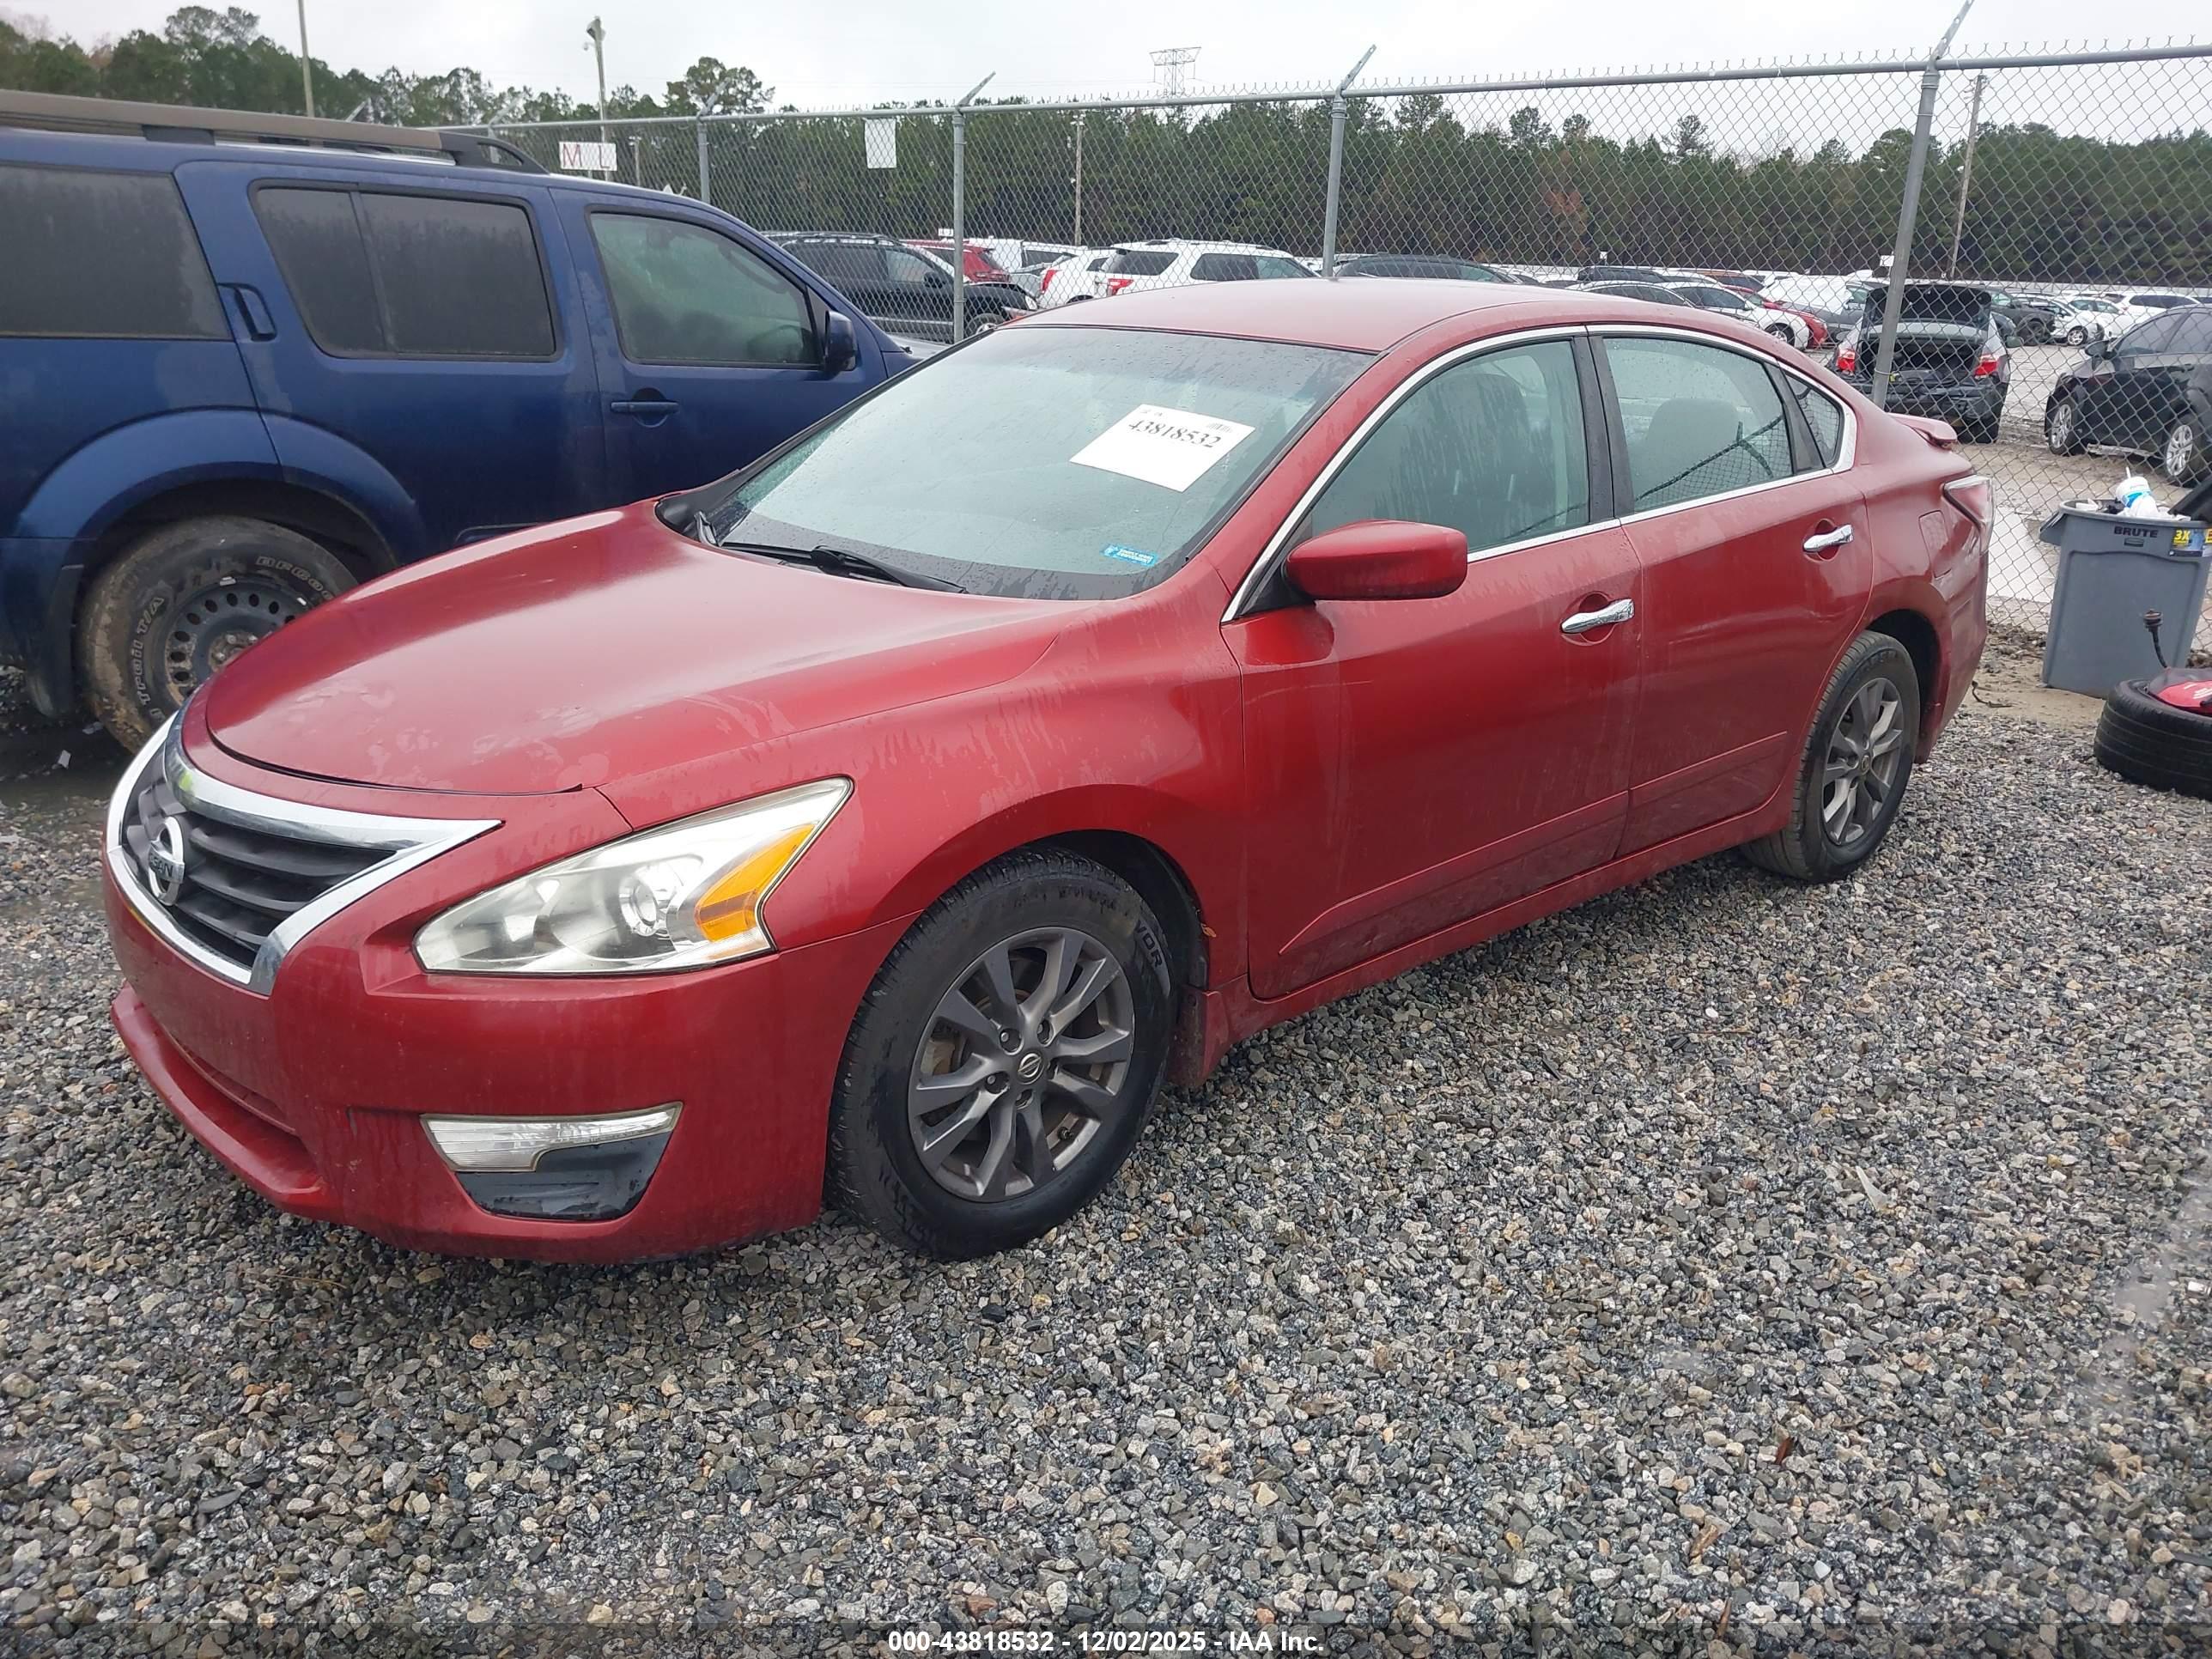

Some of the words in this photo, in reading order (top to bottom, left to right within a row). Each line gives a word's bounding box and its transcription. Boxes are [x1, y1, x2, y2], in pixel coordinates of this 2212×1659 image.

[562, 144, 582, 167] M
[599, 144, 611, 168] L
[1128, 420, 1221, 447] 43818532
[2113, 526, 2159, 538] BRUTE
